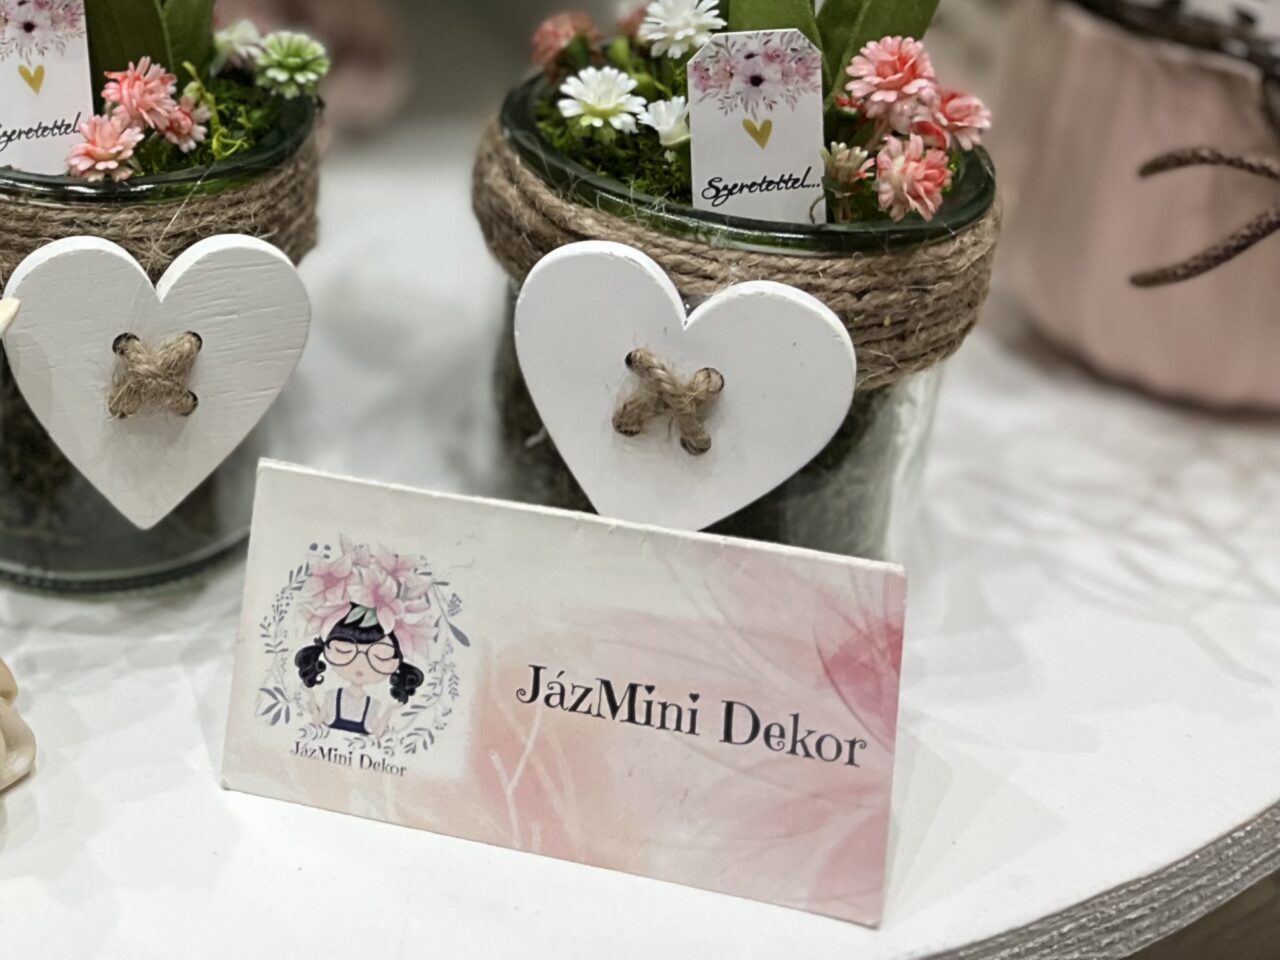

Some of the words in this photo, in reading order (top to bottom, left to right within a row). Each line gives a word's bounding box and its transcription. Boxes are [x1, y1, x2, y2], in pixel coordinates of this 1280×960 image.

[701, 166, 820, 207] Szeretettel...
[516, 664, 700, 736] JázMini
[719, 700, 867, 768] Dekor
[290, 741, 353, 767] JázMini
[359, 753, 408, 777] Dekor
